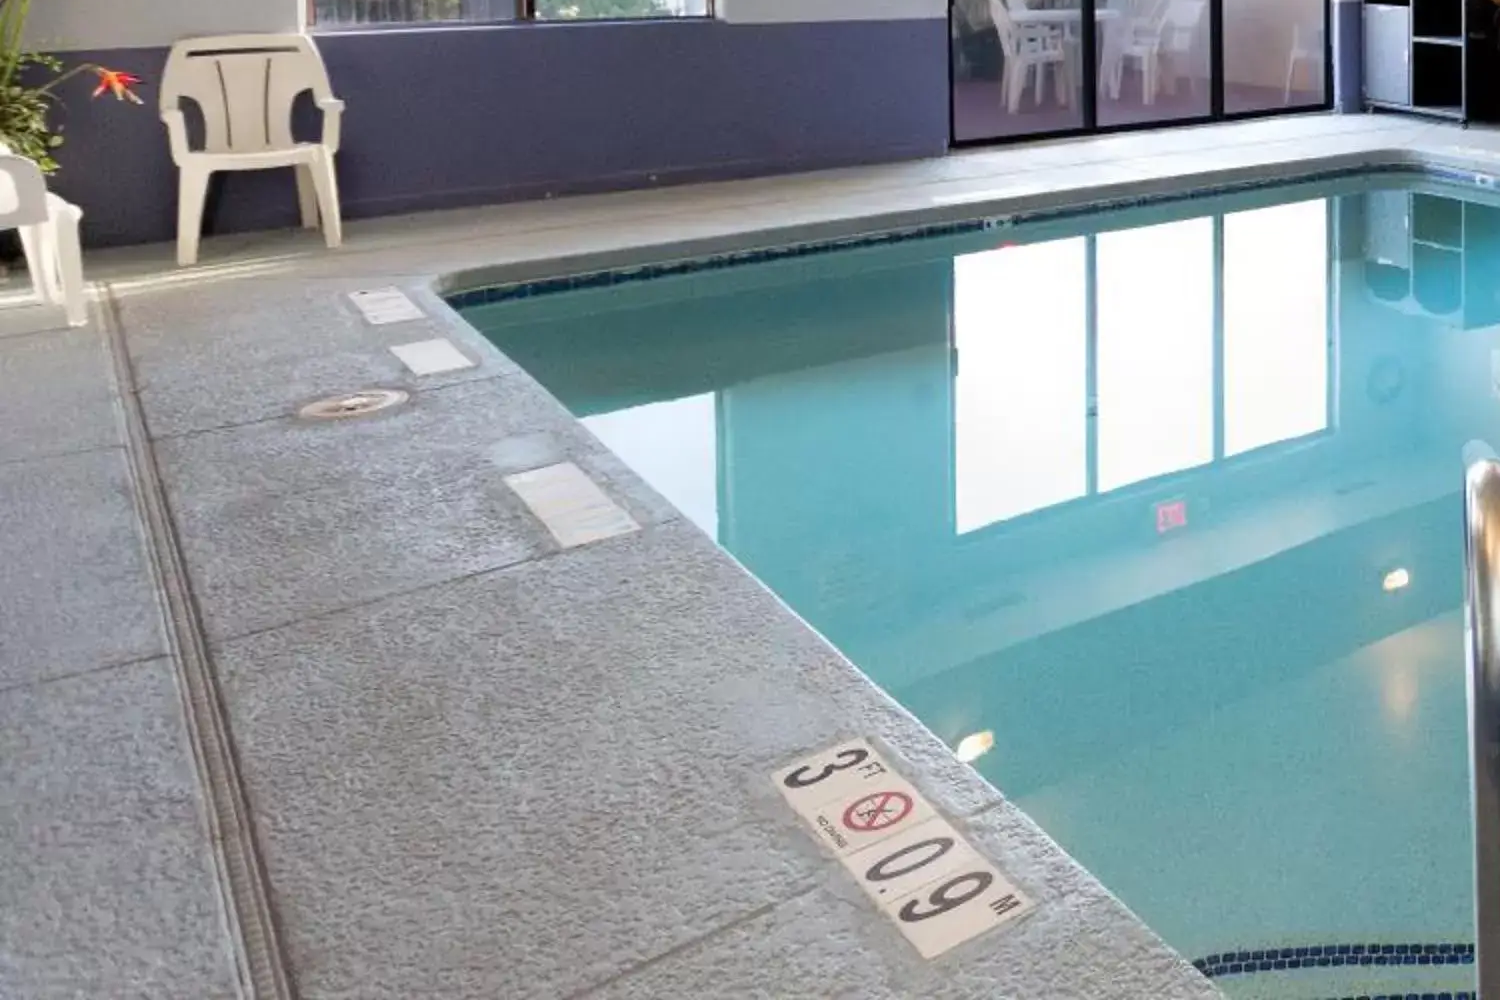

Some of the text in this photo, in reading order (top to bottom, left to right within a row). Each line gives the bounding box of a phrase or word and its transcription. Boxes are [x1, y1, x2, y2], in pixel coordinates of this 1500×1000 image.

[784, 747, 887, 789] 3 FT
[865, 836, 1021, 923] 0.9 M
